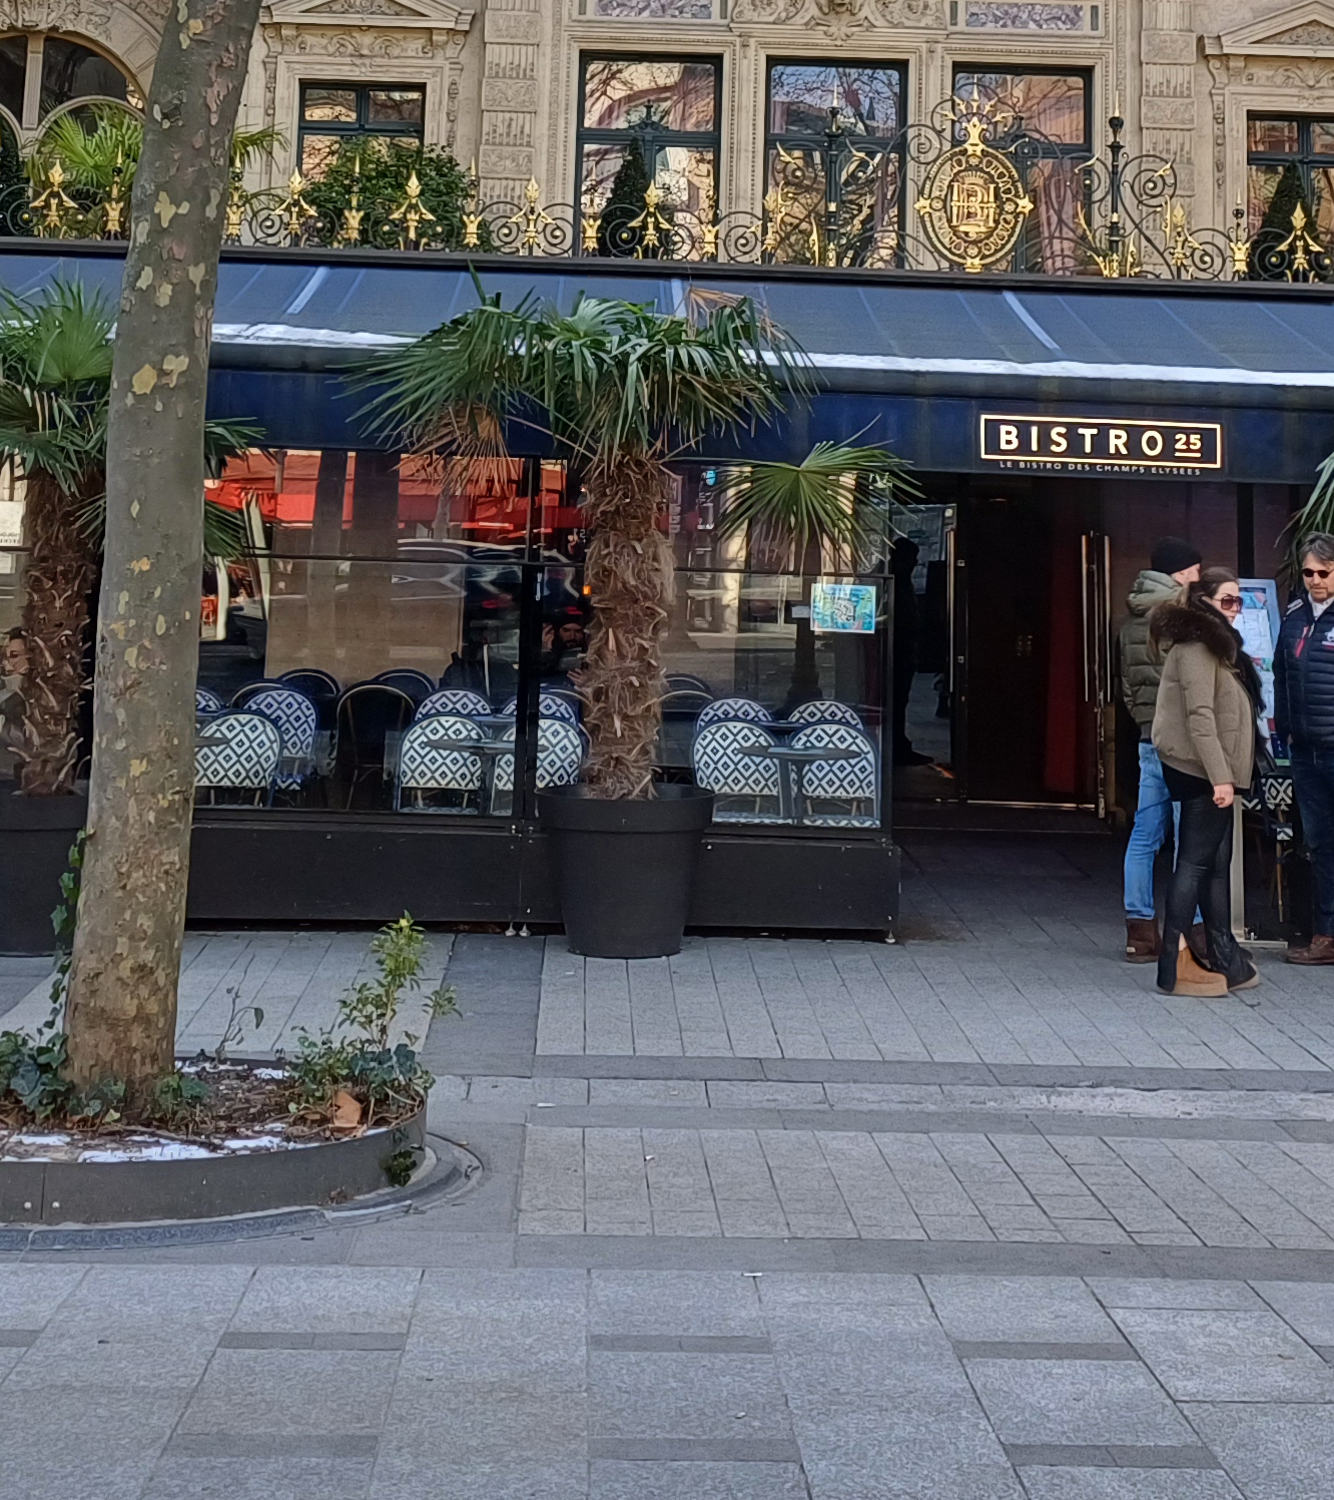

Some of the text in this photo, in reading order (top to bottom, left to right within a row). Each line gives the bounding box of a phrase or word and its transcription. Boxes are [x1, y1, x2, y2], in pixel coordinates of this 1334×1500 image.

[999, 425, 1202, 456] BISTRO 25
[999, 460, 1013, 469] LE
[1019, 461, 1062, 471] BISTRO
[1068, 463, 1091, 472] DES
[1096, 464, 1146, 474] CHAMPS
